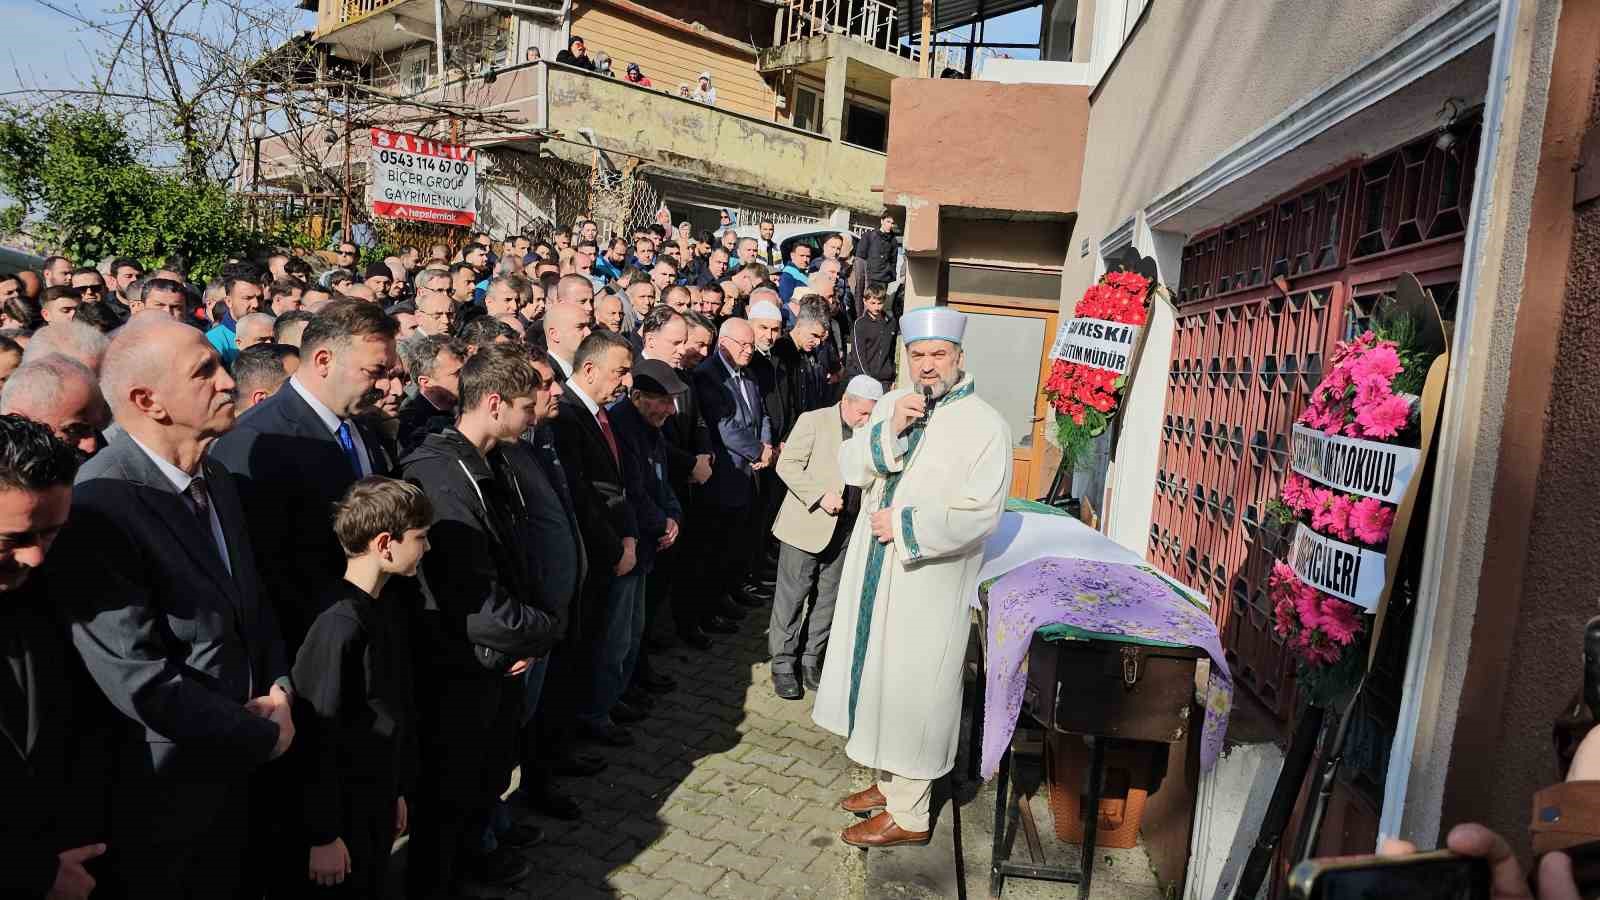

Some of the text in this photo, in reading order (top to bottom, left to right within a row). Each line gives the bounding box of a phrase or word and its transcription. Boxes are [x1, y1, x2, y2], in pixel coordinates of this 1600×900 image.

[380, 150, 469, 176] 0543 114 67 00
[388, 168, 464, 190] BİÇER GROUP
